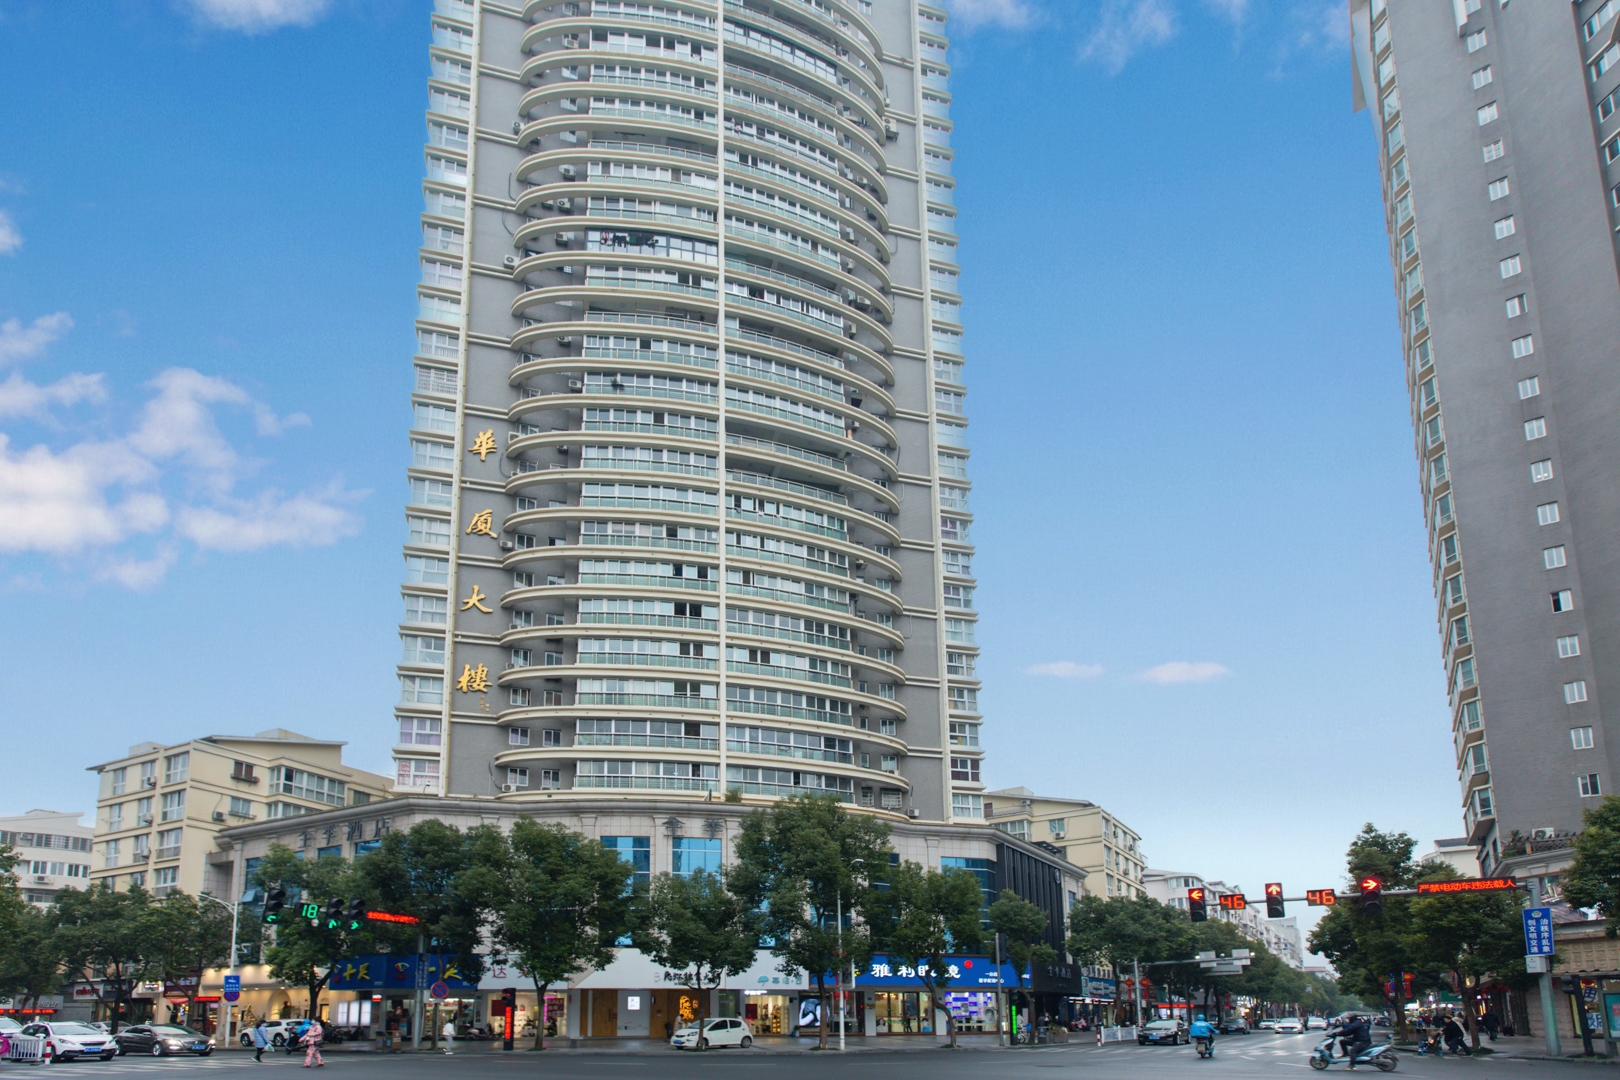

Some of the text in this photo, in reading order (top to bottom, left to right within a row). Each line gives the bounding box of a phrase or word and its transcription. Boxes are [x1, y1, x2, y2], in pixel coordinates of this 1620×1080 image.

[1418, 879, 1517, 894] 严禁电动车违法载人
[1220, 894, 1246, 910] 46
[1308, 889, 1336, 905] 46
[302, 904, 318, 919] 18
[1527, 918, 1539, 953] 创文明交通
[1540, 918, 1551, 953] 治秩序乱象
[343, 963, 370, 981] 十足
